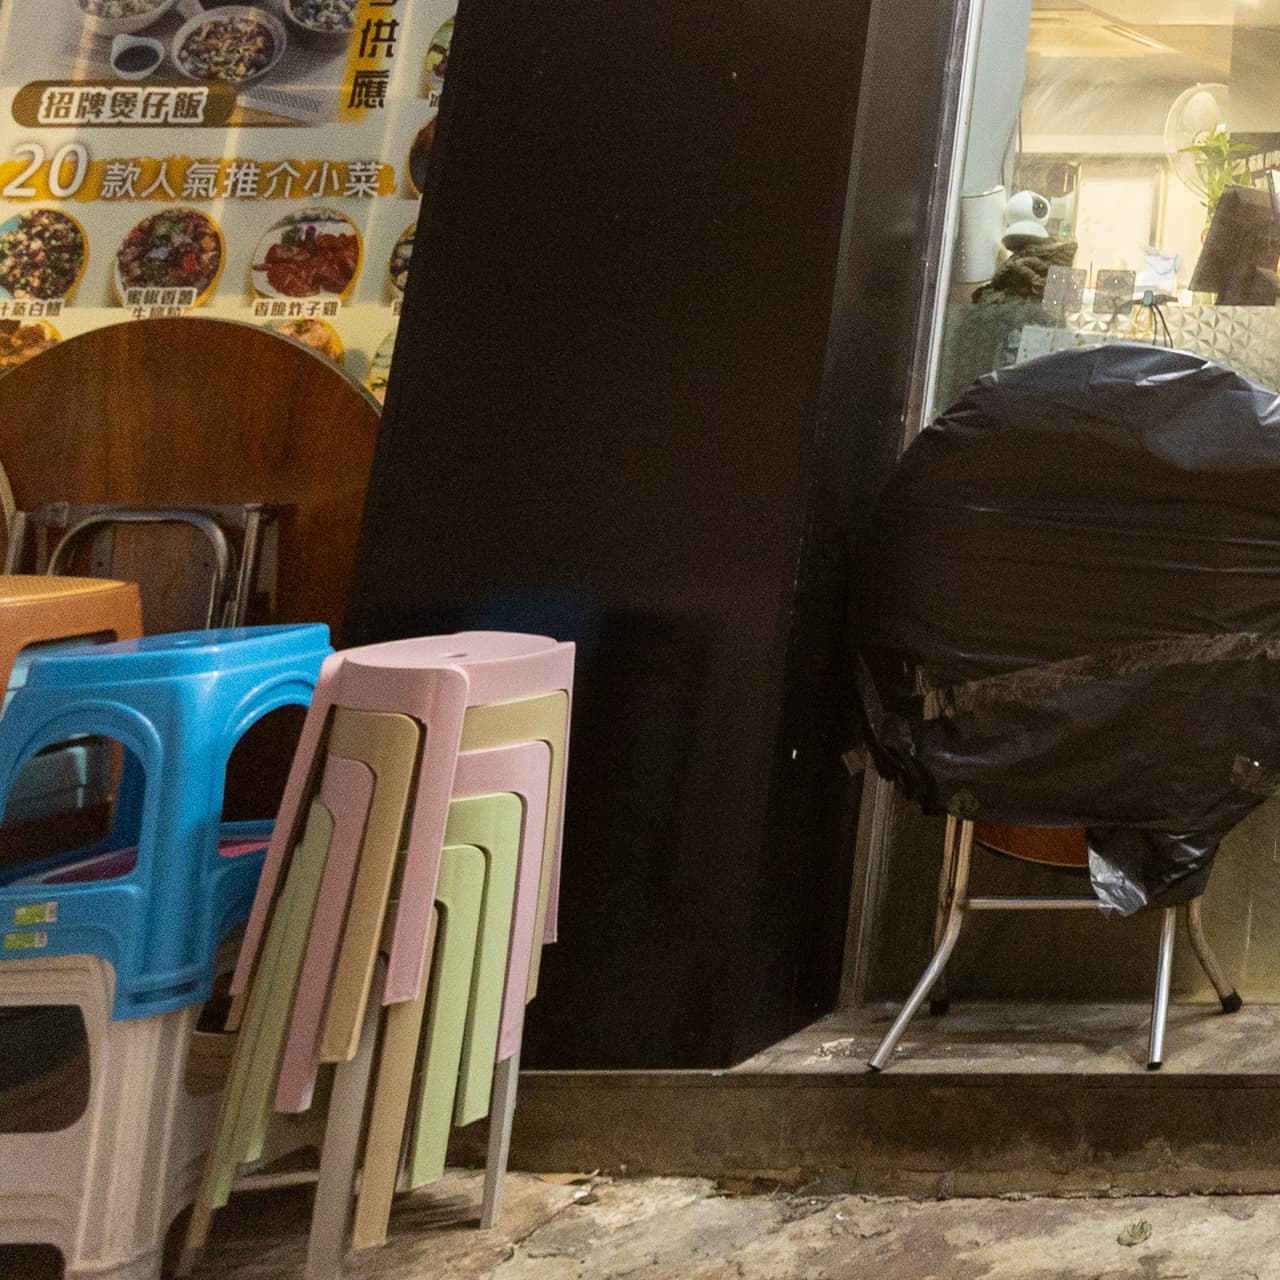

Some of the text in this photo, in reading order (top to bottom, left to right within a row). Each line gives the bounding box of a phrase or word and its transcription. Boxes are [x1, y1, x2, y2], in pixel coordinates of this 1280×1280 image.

[40, 88, 206, 122] 招牌煲仔飯
[1, 144, 383, 200] 20 款人氣推介小菜
